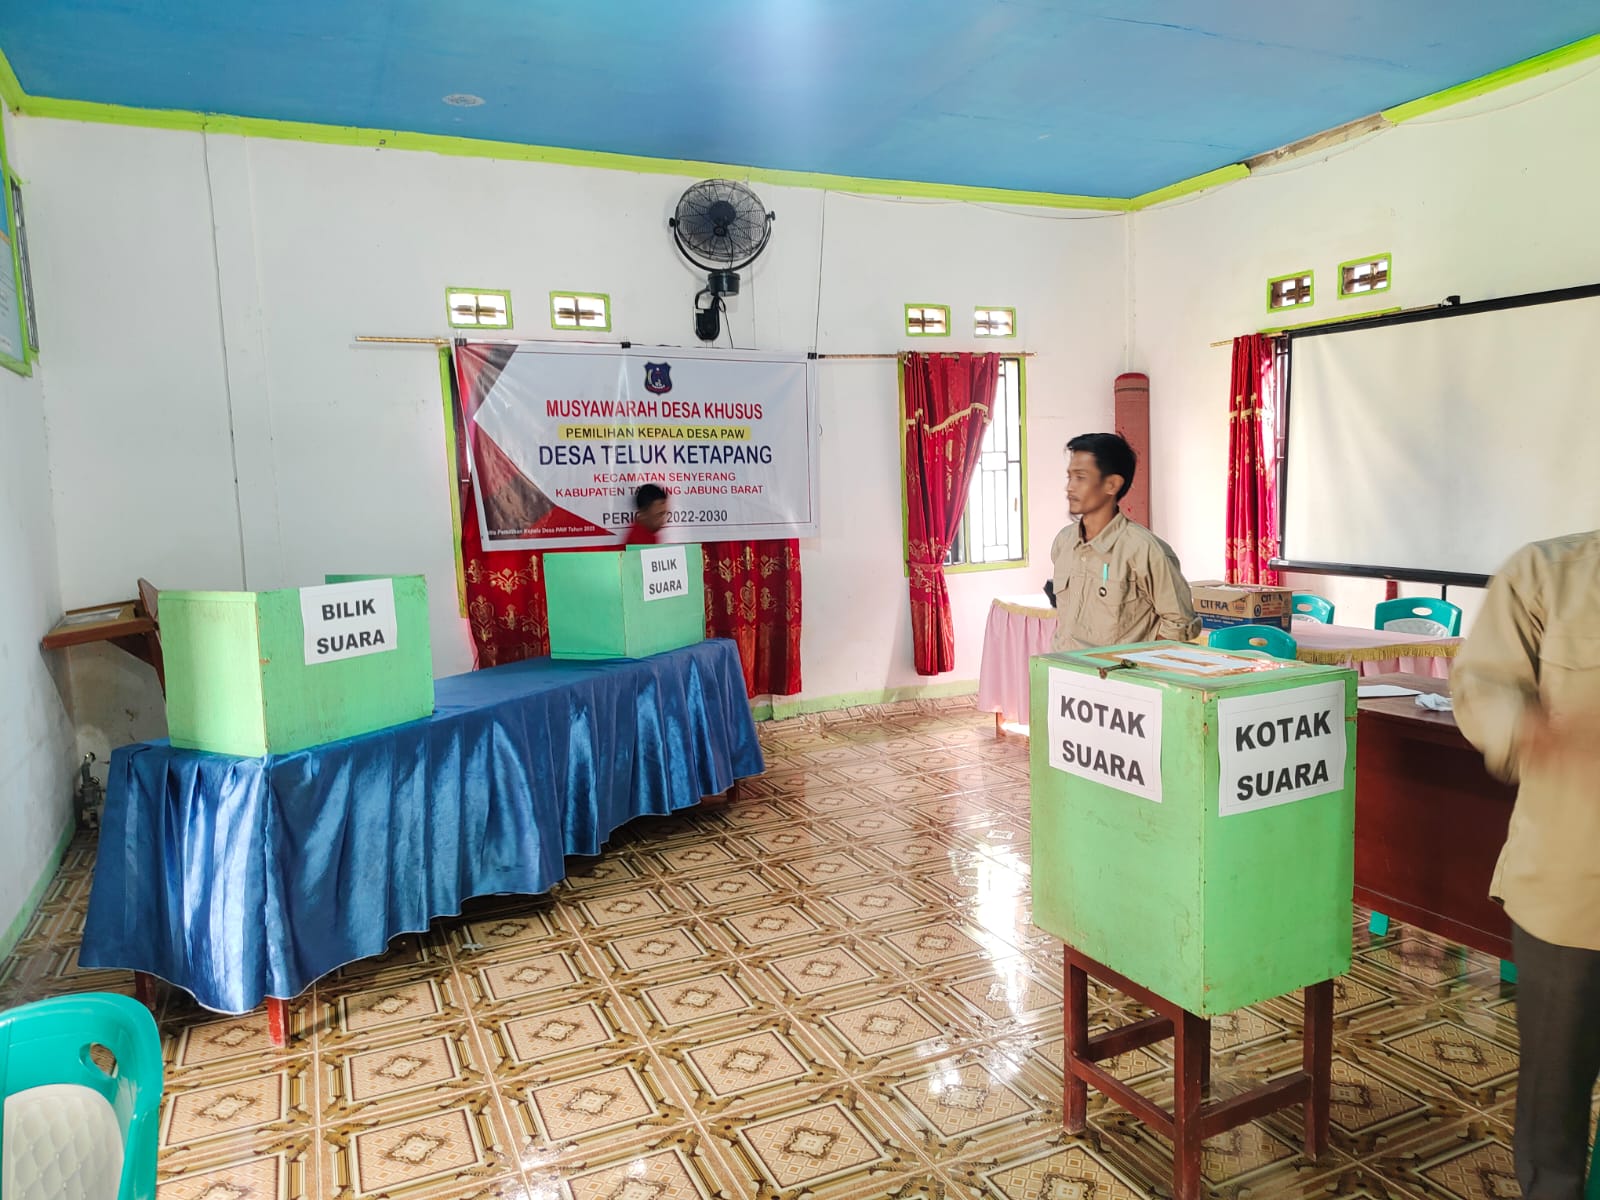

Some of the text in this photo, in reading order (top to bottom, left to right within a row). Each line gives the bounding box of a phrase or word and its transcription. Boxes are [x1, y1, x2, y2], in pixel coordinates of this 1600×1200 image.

[546, 400, 763, 420] MUSYAWARAH DESA KHUSUS
[566, 427, 745, 439] PEMILIHAN KEPALA DESA PAW
[540, 445, 772, 465] DESA TELUK KETAPANG
[593, 472, 736, 483] KECAMATAN SENYERANG
[555, 487, 625, 497] KABUPATEN
[685, 485, 728, 495] JABUNG
[731, 485, 764, 495] BARAT
[666, 510, 728, 523] 2022-2030
[651, 558, 677, 573] BILIK
[648, 579, 683, 595] SUARA
[321, 598, 376, 621] BILIK
[316, 629, 385, 654] SUARA
[1061, 695, 1147, 738] KOTAK
[1236, 710, 1332, 752] KOTAK
[1062, 739, 1145, 786] SUARA
[1236, 760, 1329, 802] SUARA
